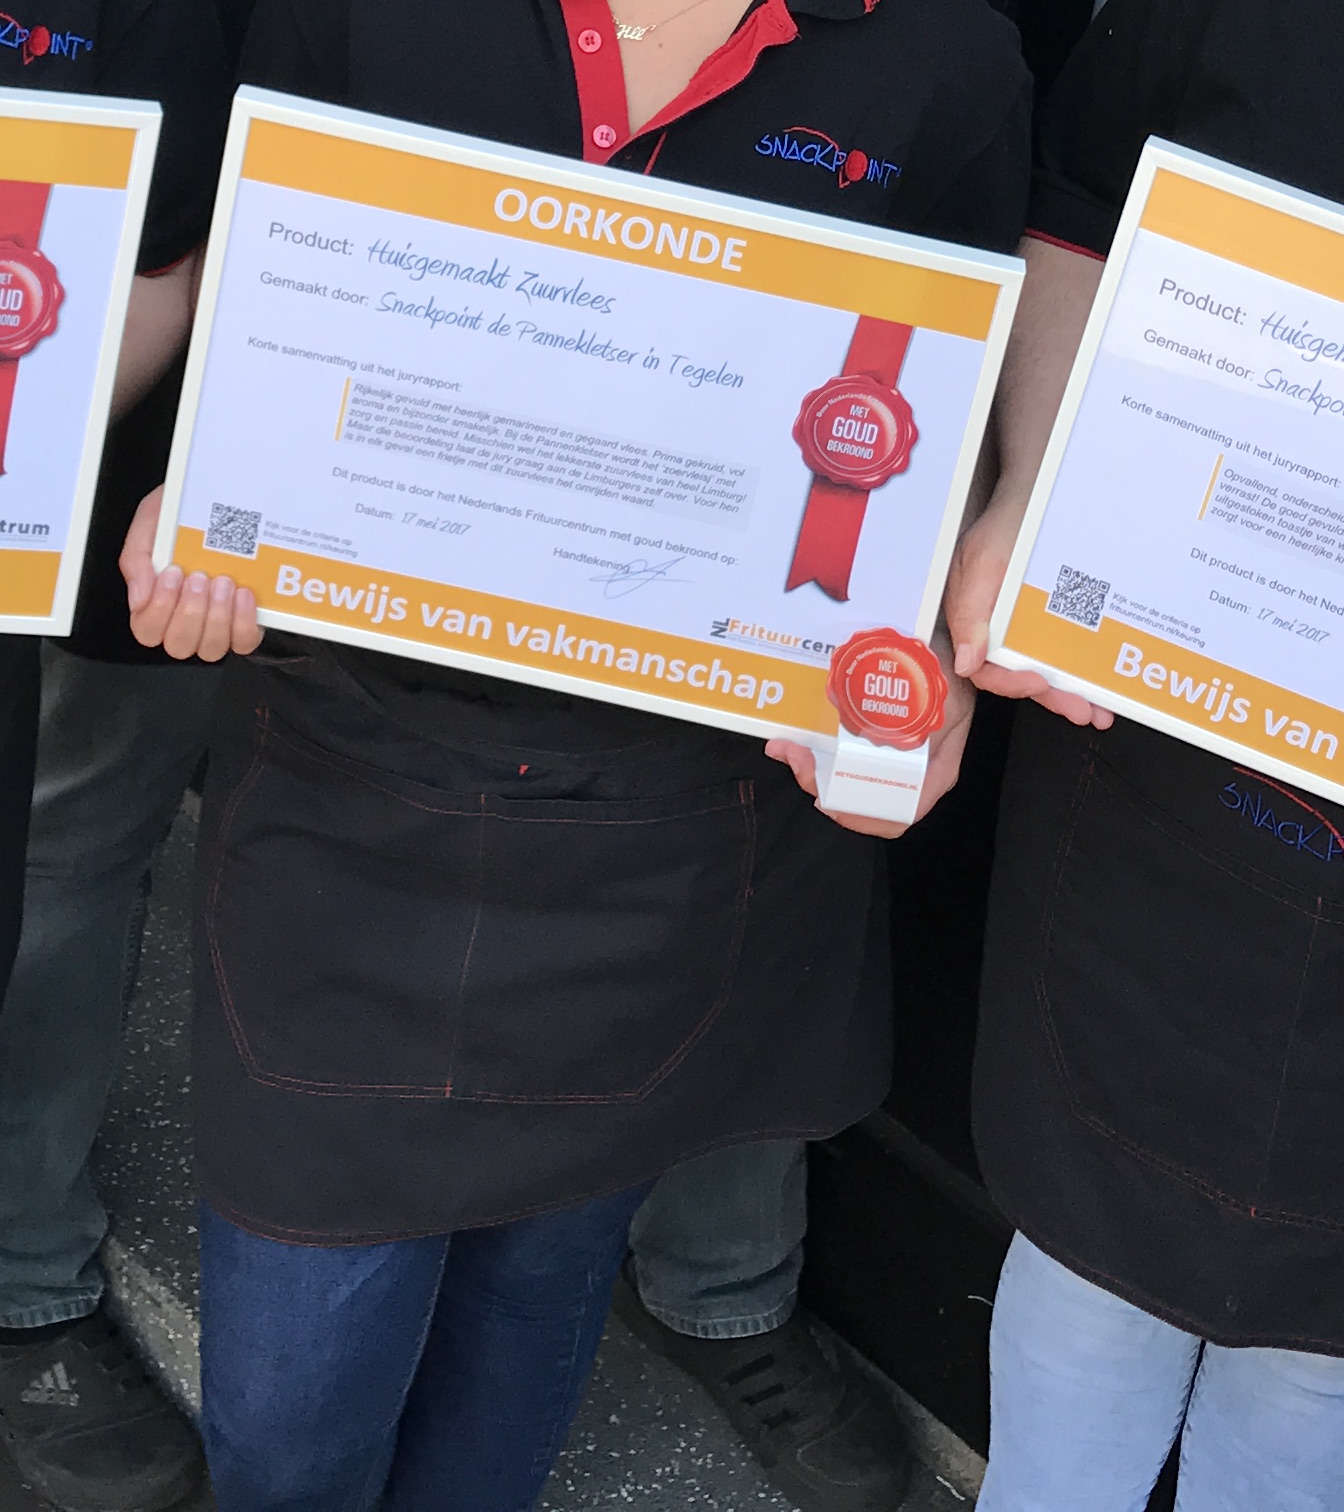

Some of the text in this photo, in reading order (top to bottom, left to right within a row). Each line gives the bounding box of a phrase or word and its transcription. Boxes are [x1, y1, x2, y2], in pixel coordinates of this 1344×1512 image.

[493, 187, 747, 272] OORKONDE
[268, 221, 616, 314] Product: Huisgemaakt Zuurvlees
[1158, 277, 1247, 326] Product:
[259, 270, 744, 388] Gemaakt door: Snackpoint de Pannekletser in Tegelen
[1143, 328, 1213, 366] Gemaakt
[1214, 356, 1255, 379] door:
[831, 416, 879, 445] GOUD
[849, 404, 870, 419] MET
[1120, 394, 1341, 488] Korte samenvatting uit het juryrapport:
[354, 501, 472, 535] Datum: 17 mei 2017
[1189, 546, 1207, 563] Dit
[1207, 556, 1254, 581] product
[1254, 574, 1266, 585] is
[1267, 579, 1297, 596] door
[1297, 588, 1318, 606] het
[274, 563, 784, 709] Bewijs van vakmanschap
[728, 618, 836, 655] Frituurcen
[1208, 589, 1330, 644] Datum: 17 mei 2017
[863, 673, 910, 702] GOUD
[878, 659, 898, 674] MET
[1113, 641, 1251, 723] Bewijs
[1264, 708, 1338, 760] van
